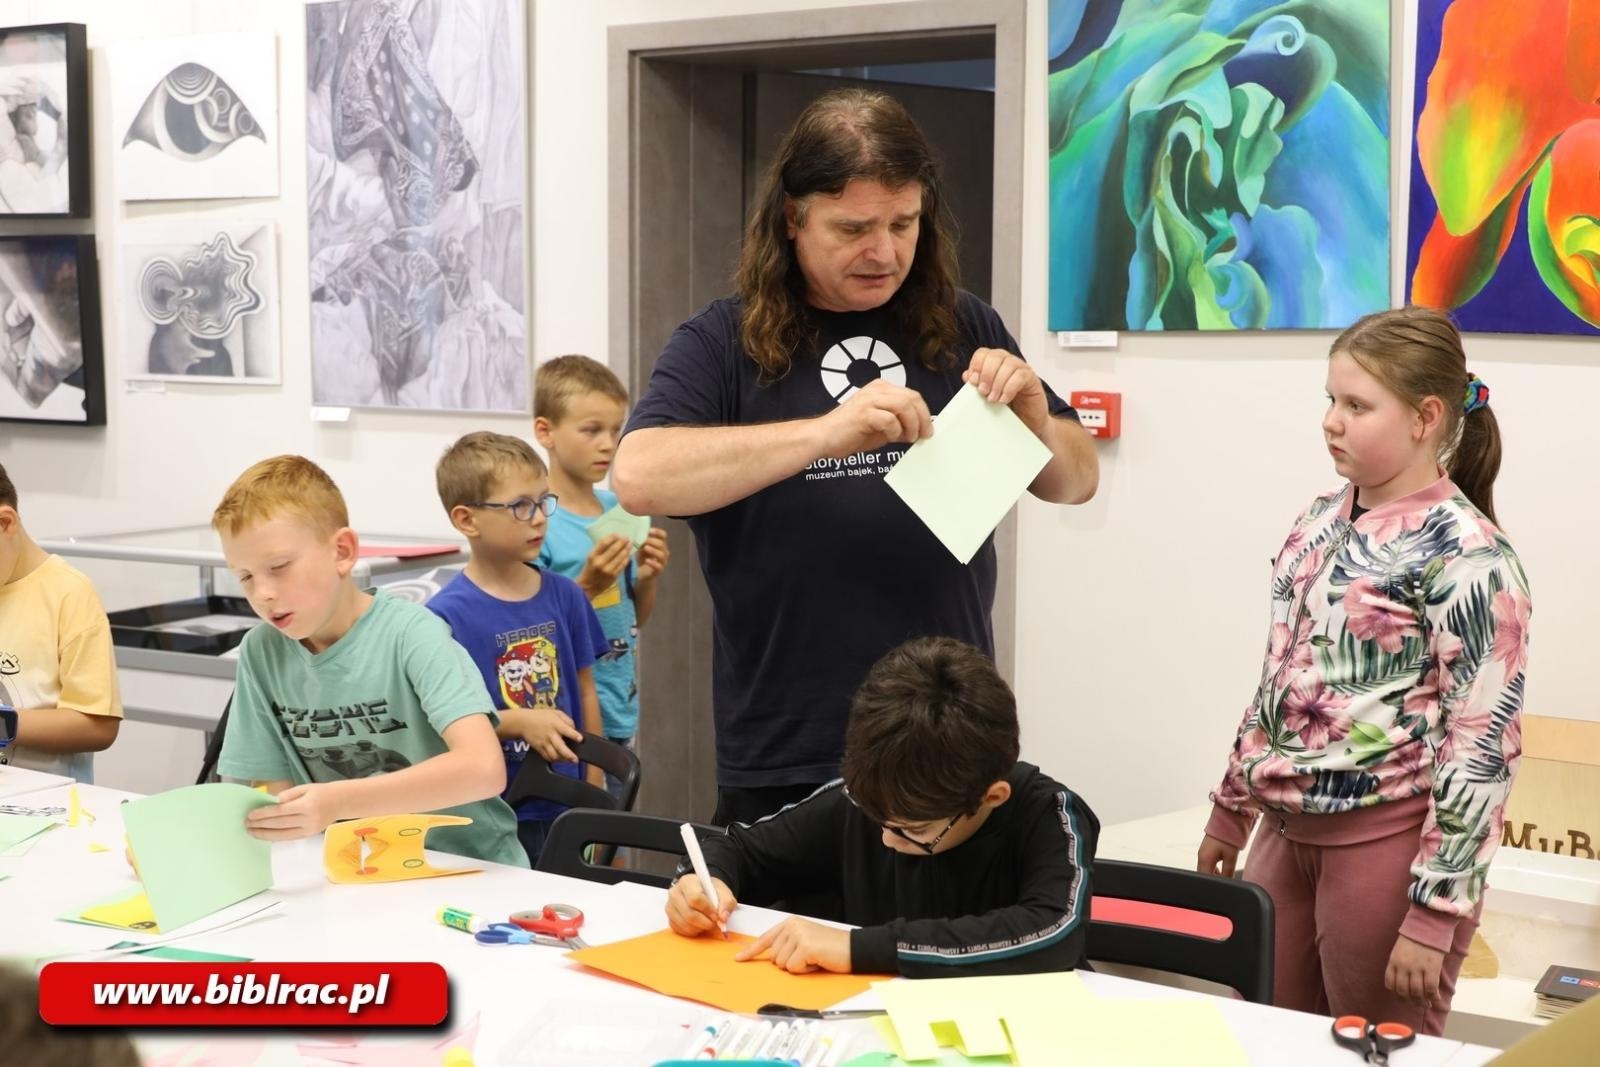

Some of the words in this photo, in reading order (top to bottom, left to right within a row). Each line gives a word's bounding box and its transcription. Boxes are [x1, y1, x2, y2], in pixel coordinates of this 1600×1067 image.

[805, 470, 845, 480] muzeum
[847, 466, 875, 477] bajek,
[496, 620, 556, 647] HEROES
[1502, 820, 1600, 860] MuB
